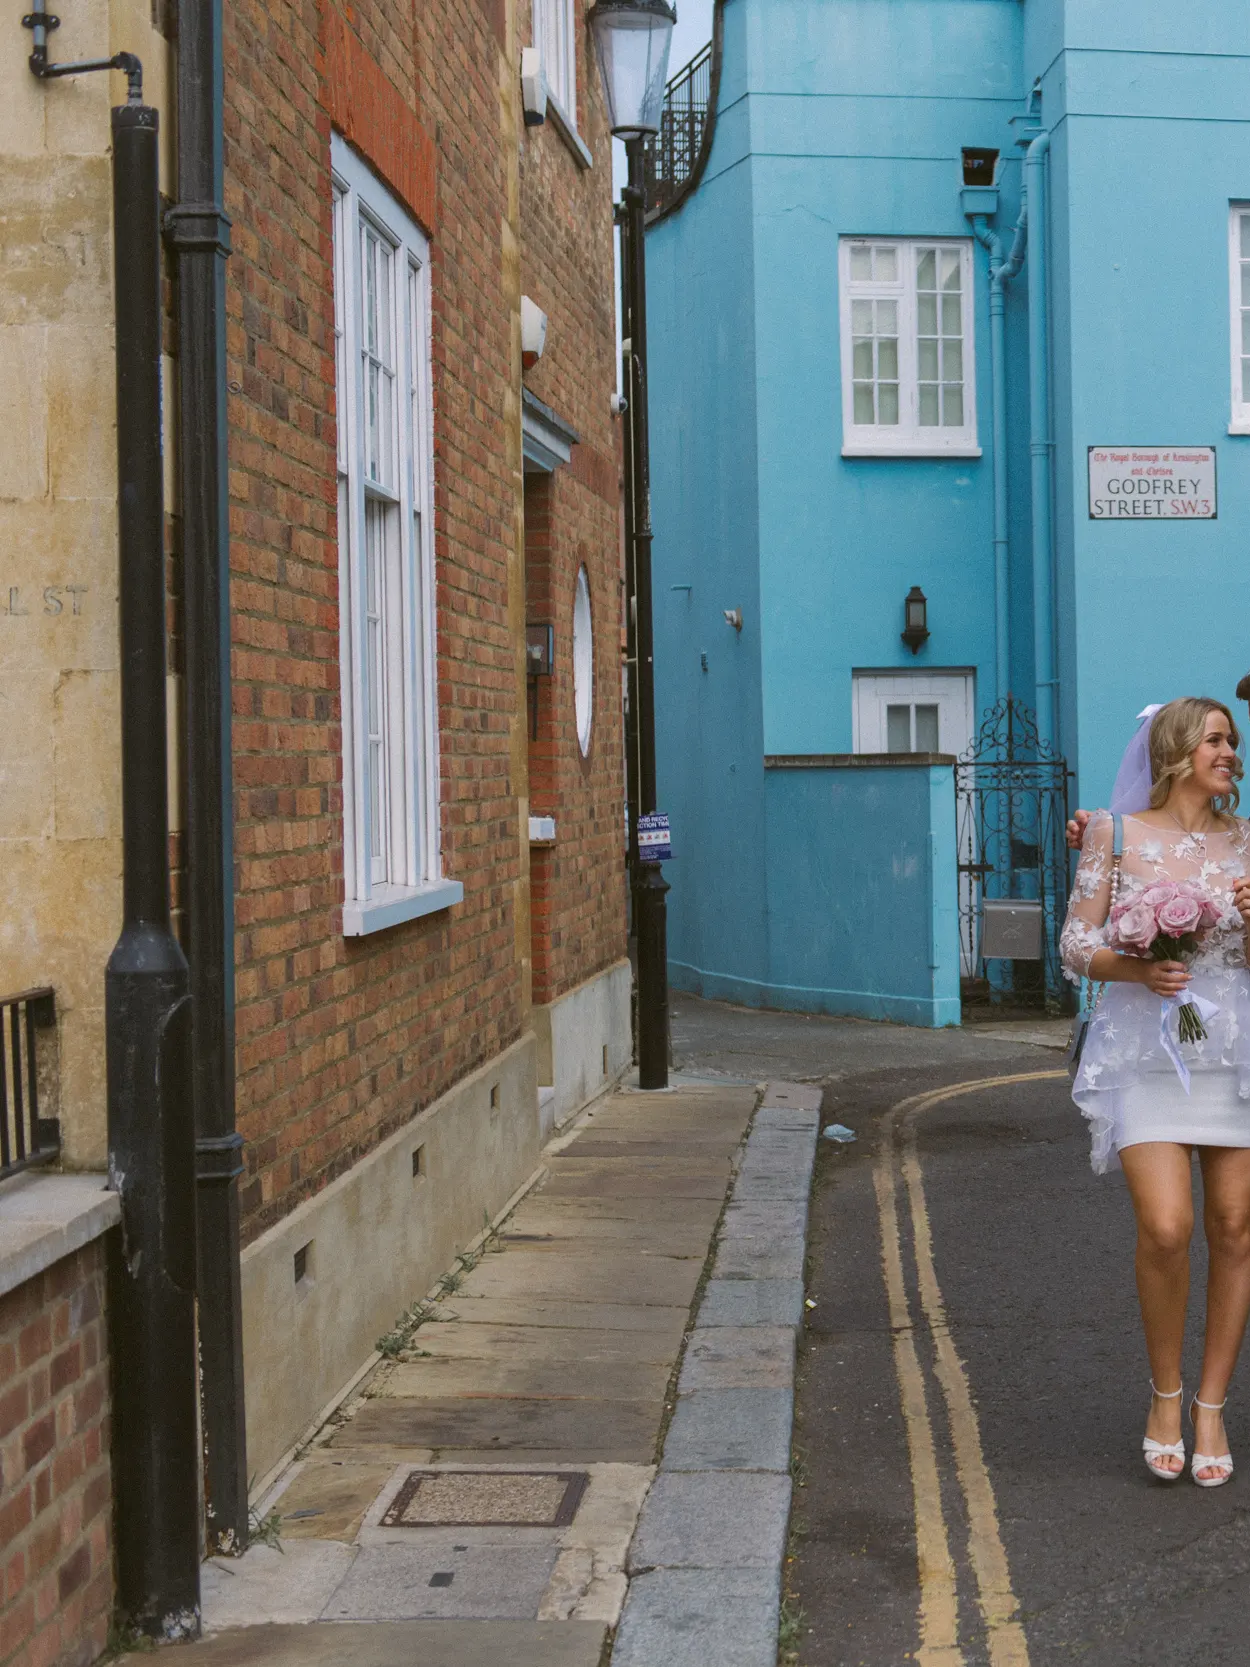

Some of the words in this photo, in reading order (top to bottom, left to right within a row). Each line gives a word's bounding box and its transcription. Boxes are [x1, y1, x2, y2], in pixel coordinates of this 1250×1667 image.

[1163, 452, 1170, 462] of
[1107, 478, 1201, 495] GODFREY
[43, 584, 88, 617] ST
